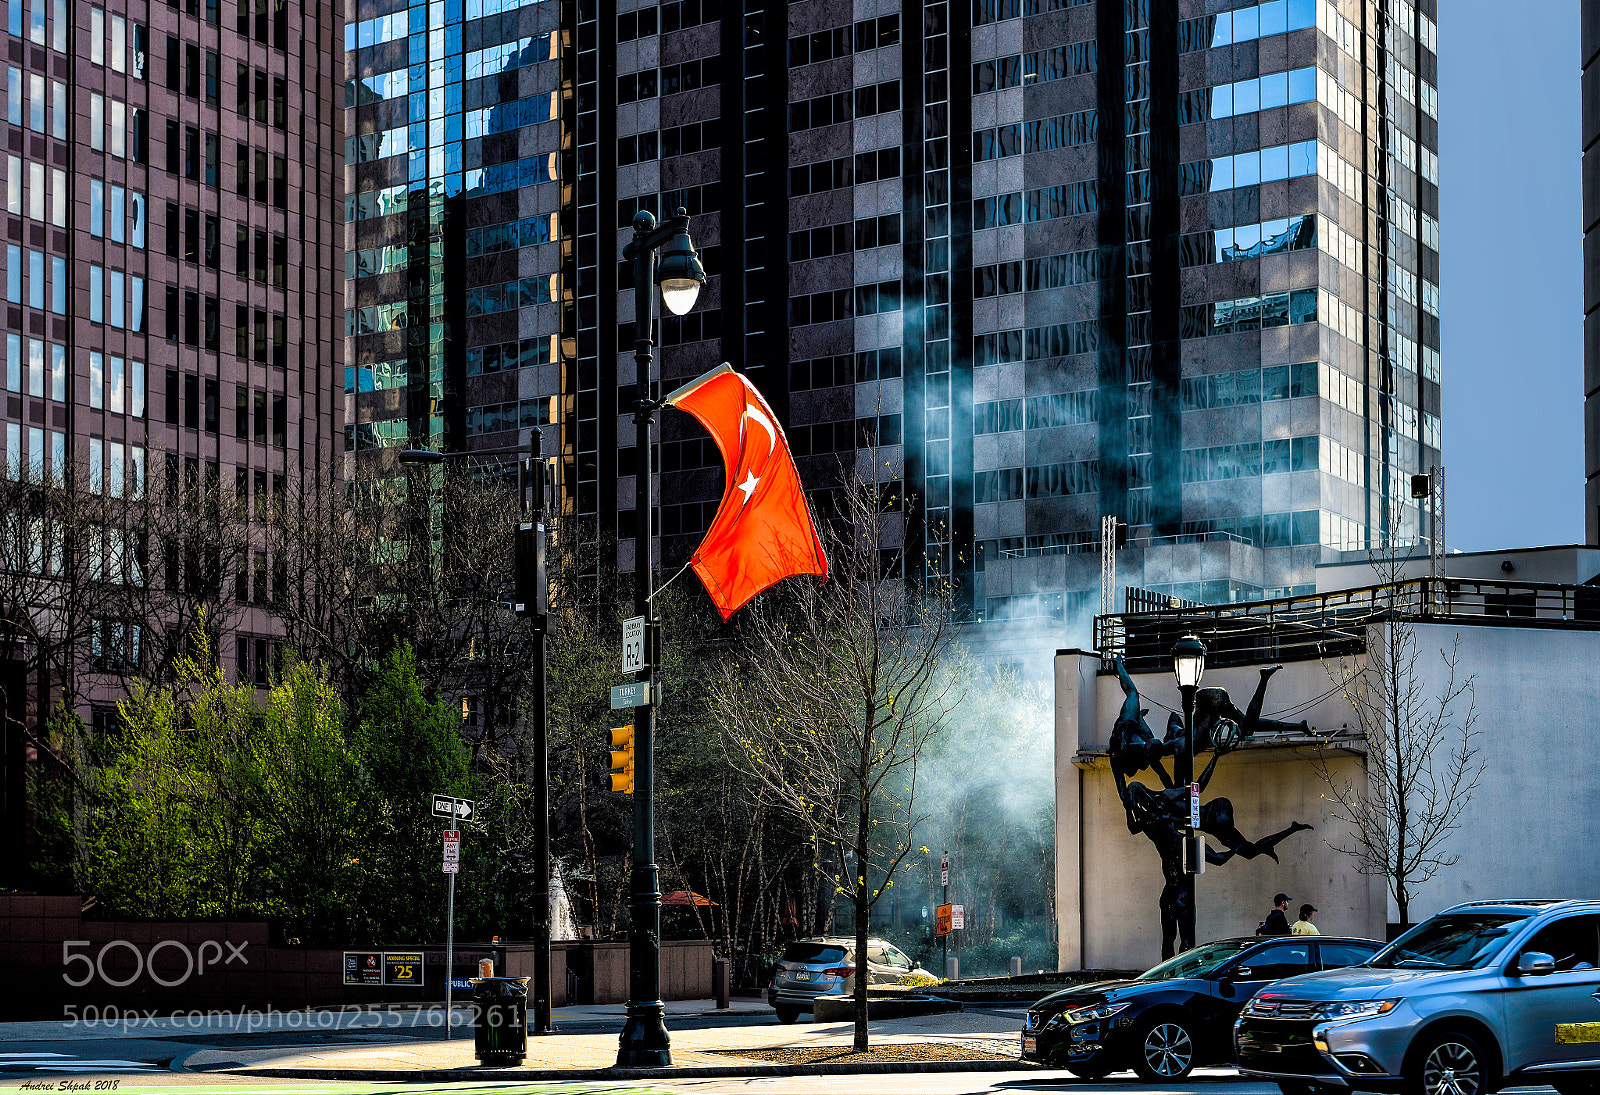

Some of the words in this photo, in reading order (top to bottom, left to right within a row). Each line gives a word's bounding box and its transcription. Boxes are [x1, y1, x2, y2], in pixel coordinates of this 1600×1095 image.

[625, 630, 642, 639] LOCATION
[619, 686, 637, 697] TURKEY
[437, 801, 448, 811] ONE
[394, 965, 413, 979] $25
[450, 980, 471, 988] PUBLIC
